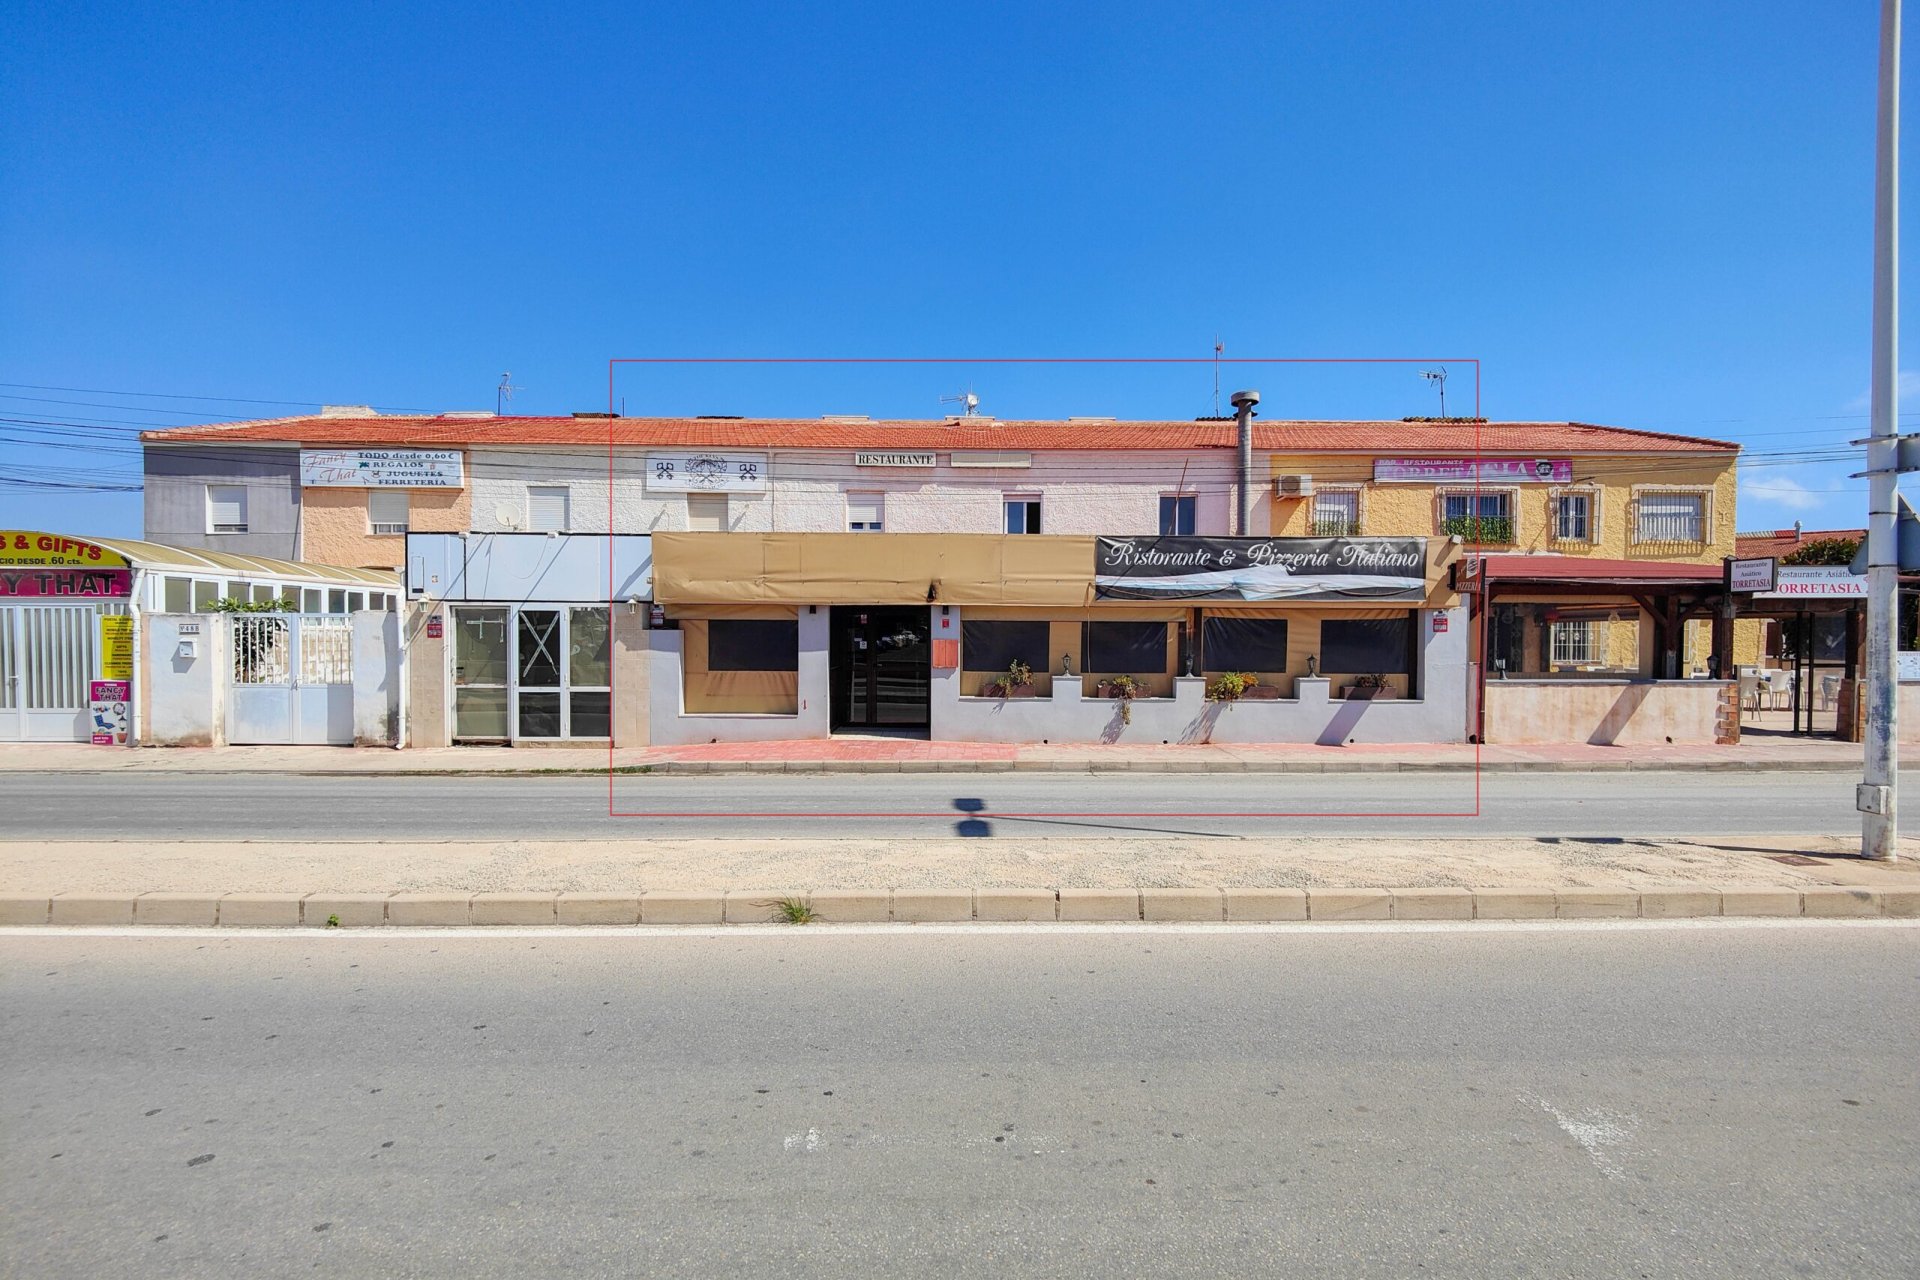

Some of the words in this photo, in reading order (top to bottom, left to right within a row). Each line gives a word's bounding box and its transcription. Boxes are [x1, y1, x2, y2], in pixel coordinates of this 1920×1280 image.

[858, 455, 934, 464] RESTAURANTE
[320, 468, 356, 483] That
[14, 534, 30, 550] &
[37, 536, 102, 560] GIFTS
[1105, 541, 1211, 566] Ristorante
[1219, 549, 1236, 566] &
[1247, 541, 1329, 571] Pizzeria
[1336, 543, 1419, 567] Italiano
[33, 573, 117, 595] THAT
[1732, 579, 1770, 589] TORRETASIA
[1777, 583, 1862, 593] ORRETASIA
[96, 686, 125, 694] FANCY
